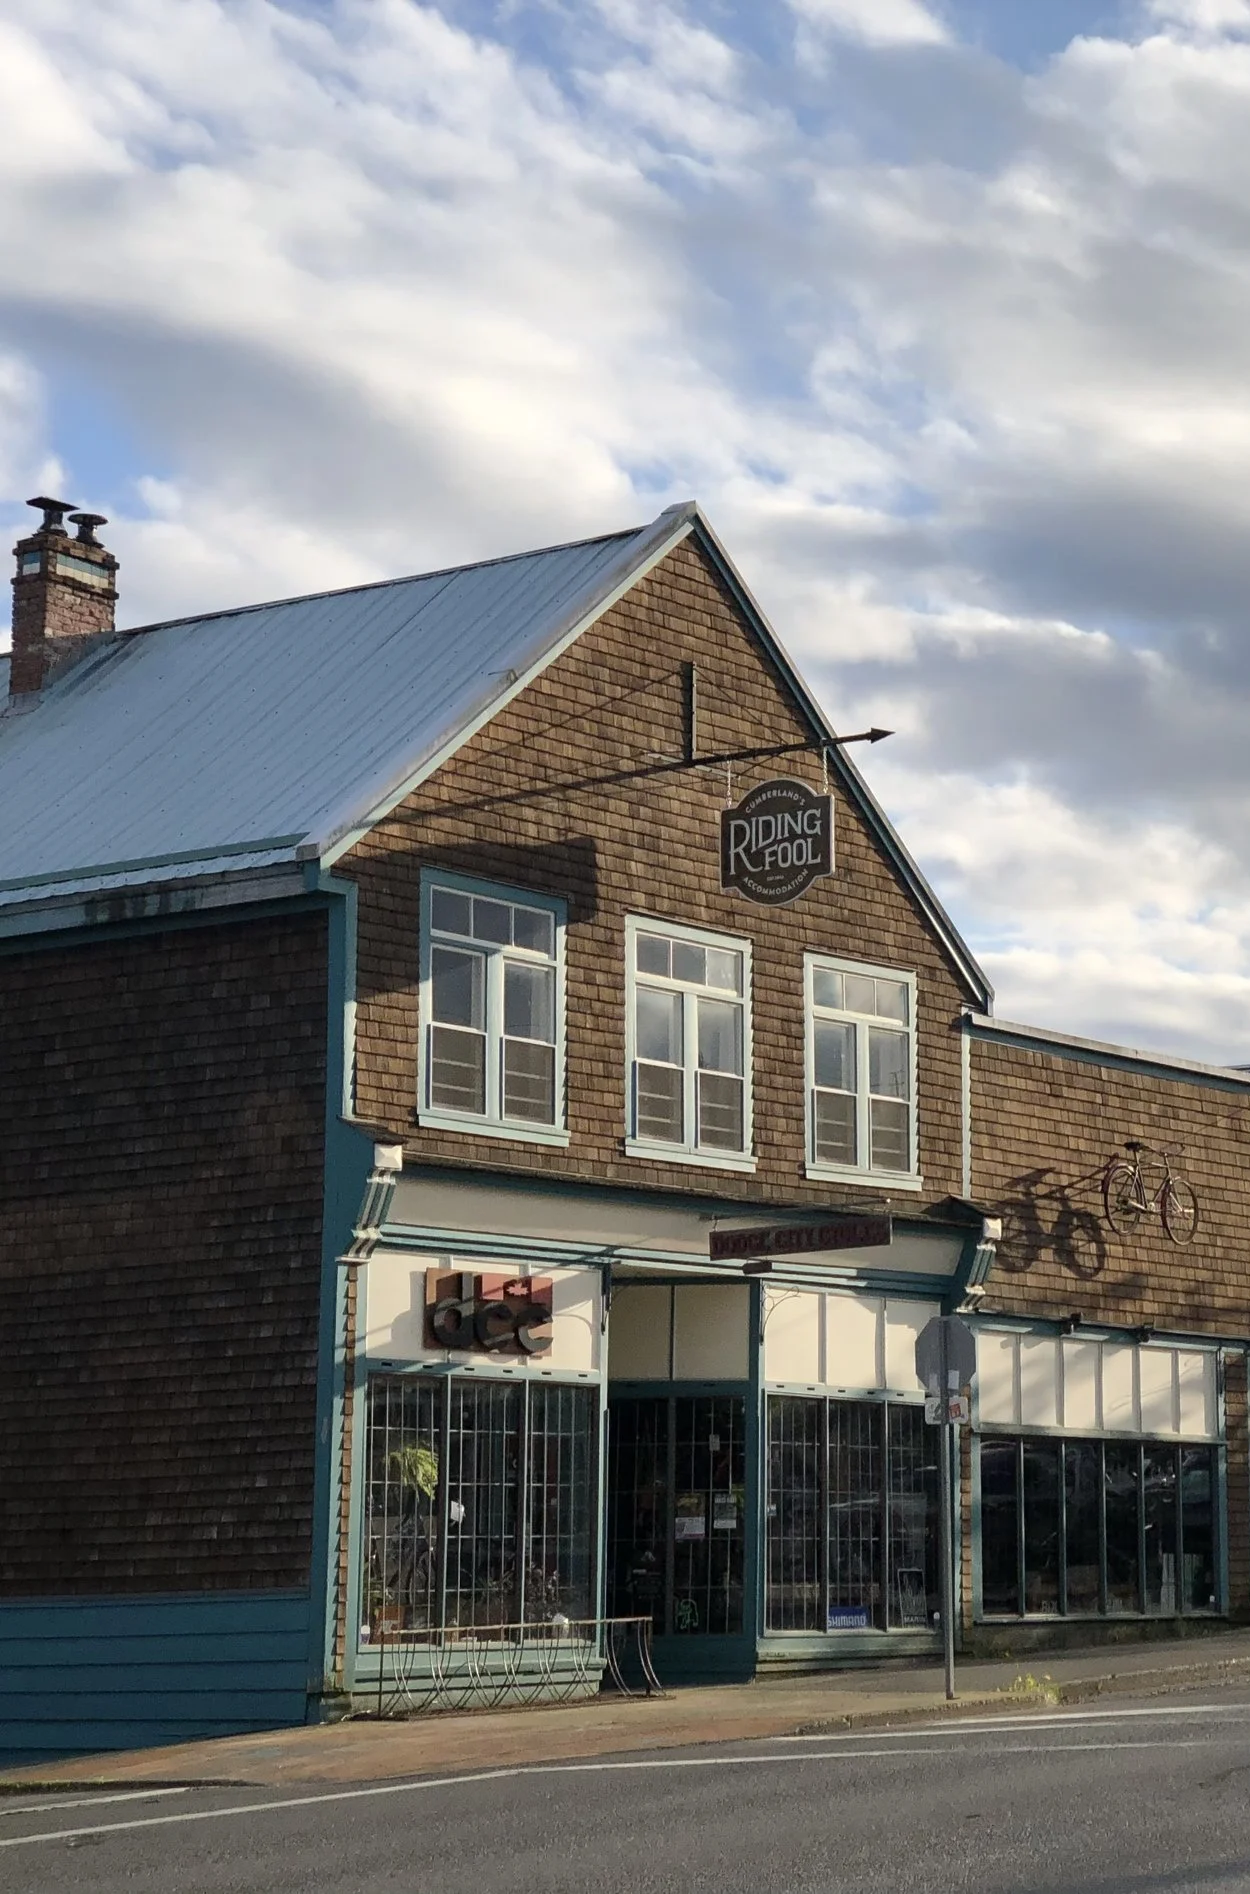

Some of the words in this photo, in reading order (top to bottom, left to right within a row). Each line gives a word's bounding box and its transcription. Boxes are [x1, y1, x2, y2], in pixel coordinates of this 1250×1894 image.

[745, 789, 806, 814] CUMBERLAND'S
[729, 808, 822, 876] RIDING
[764, 837, 822, 871] FOOL
[743, 868, 809, 896] ACCOMMODATION
[827, 1615, 867, 1628] SHIMANO
